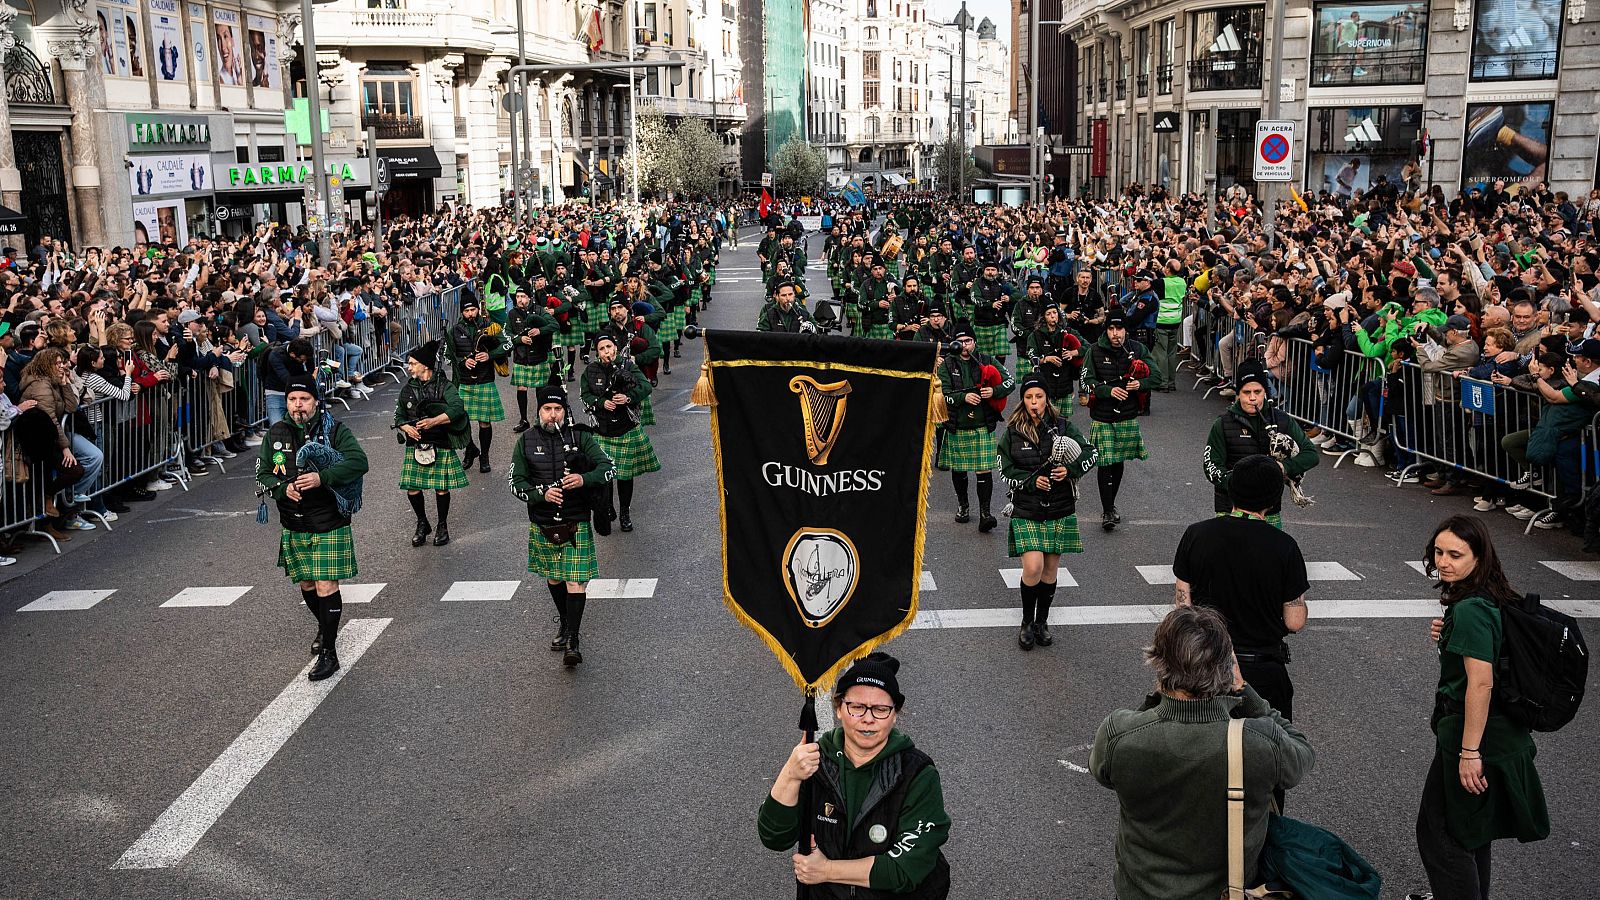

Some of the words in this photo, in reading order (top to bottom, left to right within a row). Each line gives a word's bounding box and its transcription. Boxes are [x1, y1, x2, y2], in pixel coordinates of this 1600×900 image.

[1347, 38, 1391, 48] SUPERNOVA
[132, 123, 211, 143] FARMACIA
[229, 163, 355, 186] FARMAIA
[762, 461, 882, 497] GUINNESS
[856, 676, 886, 687] GUINNESS
